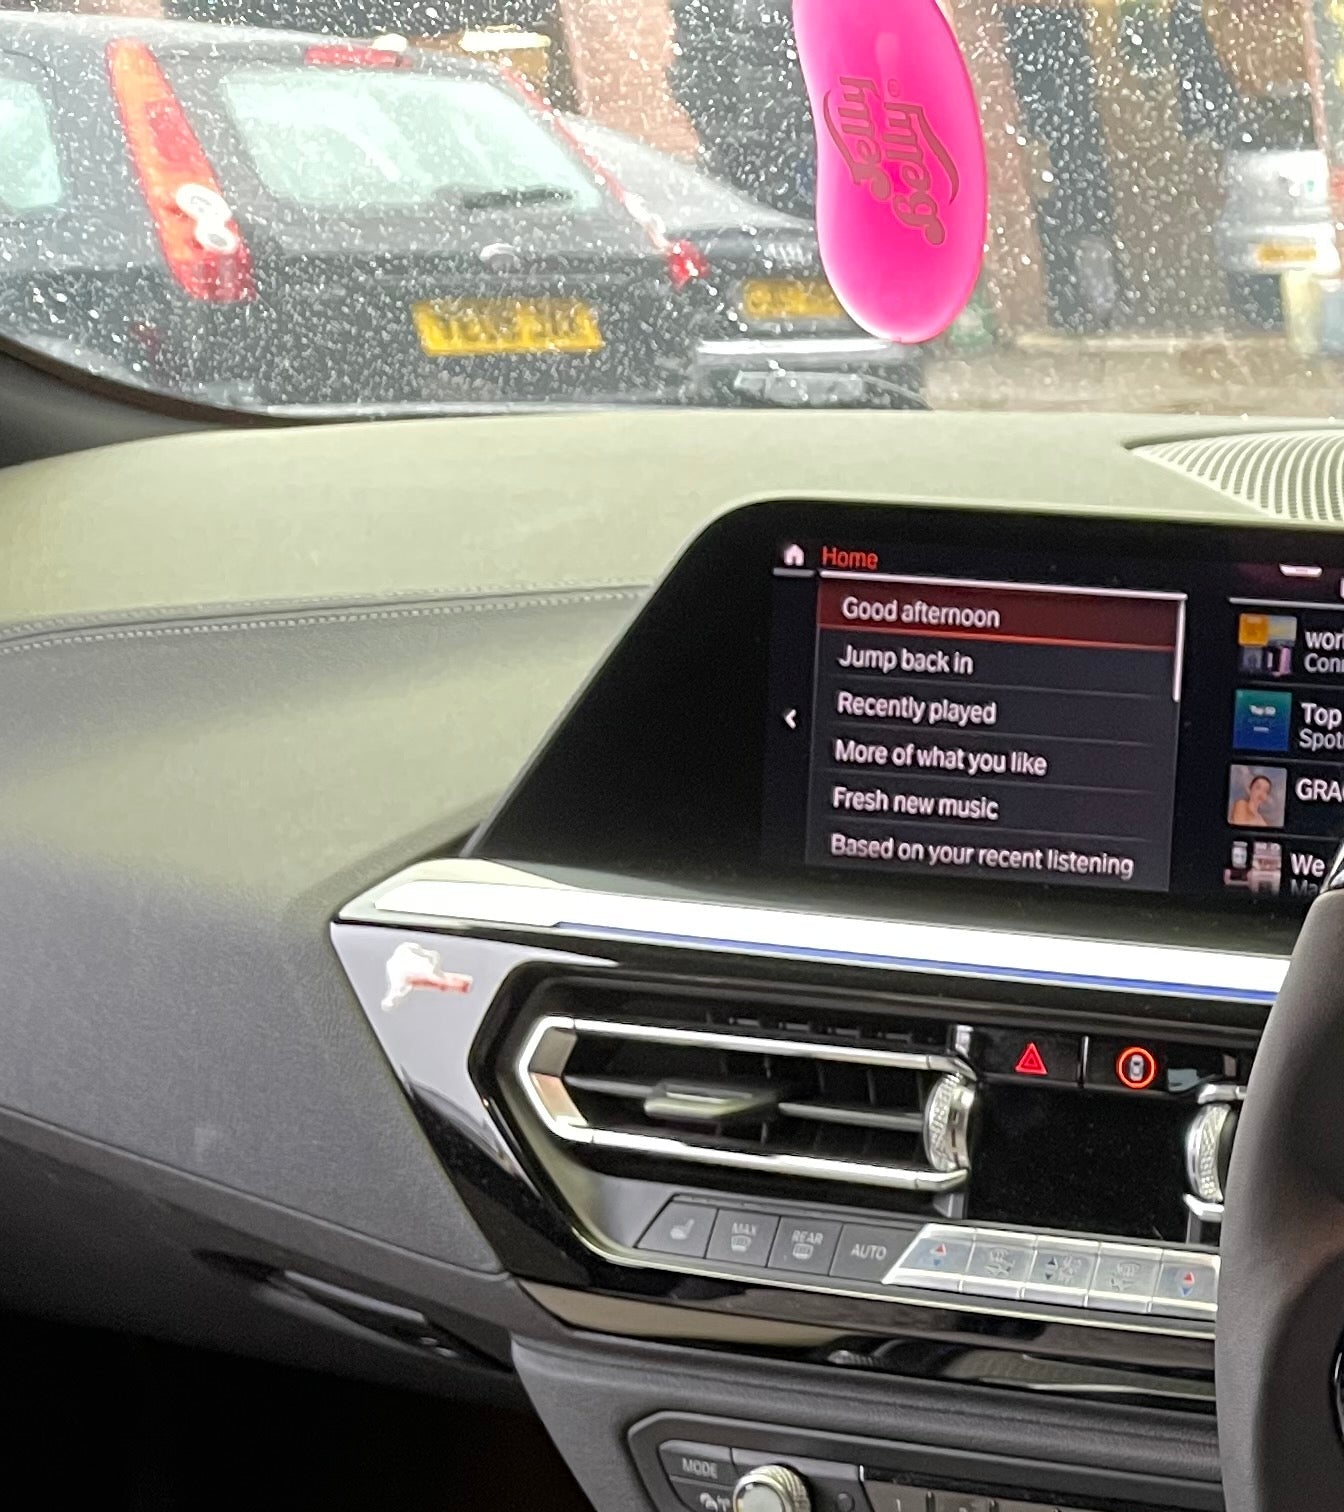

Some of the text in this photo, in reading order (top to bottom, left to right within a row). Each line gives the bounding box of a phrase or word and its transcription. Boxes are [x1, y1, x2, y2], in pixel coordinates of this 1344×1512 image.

[828, 76, 891, 201] Jelly
[882, 102, 956, 246] Belly
[822, 546, 879, 570] Home
[842, 596, 1000, 629] Good afternoon
[838, 645, 974, 674] Jump back in
[837, 690, 997, 727] Recently played
[1301, 702, 1342, 730] Top
[835, 739, 1048, 777] More of what you like
[833, 785, 999, 821] Fresh new music
[830, 832, 1135, 881] Based on your recent listening
[1290, 853, 1326, 878] We
[731, 1222, 757, 1236] MAX
[791, 1230, 823, 1245] REAR
[850, 1243, 887, 1260] AUTO
[682, 1457, 718, 1480] MODE
